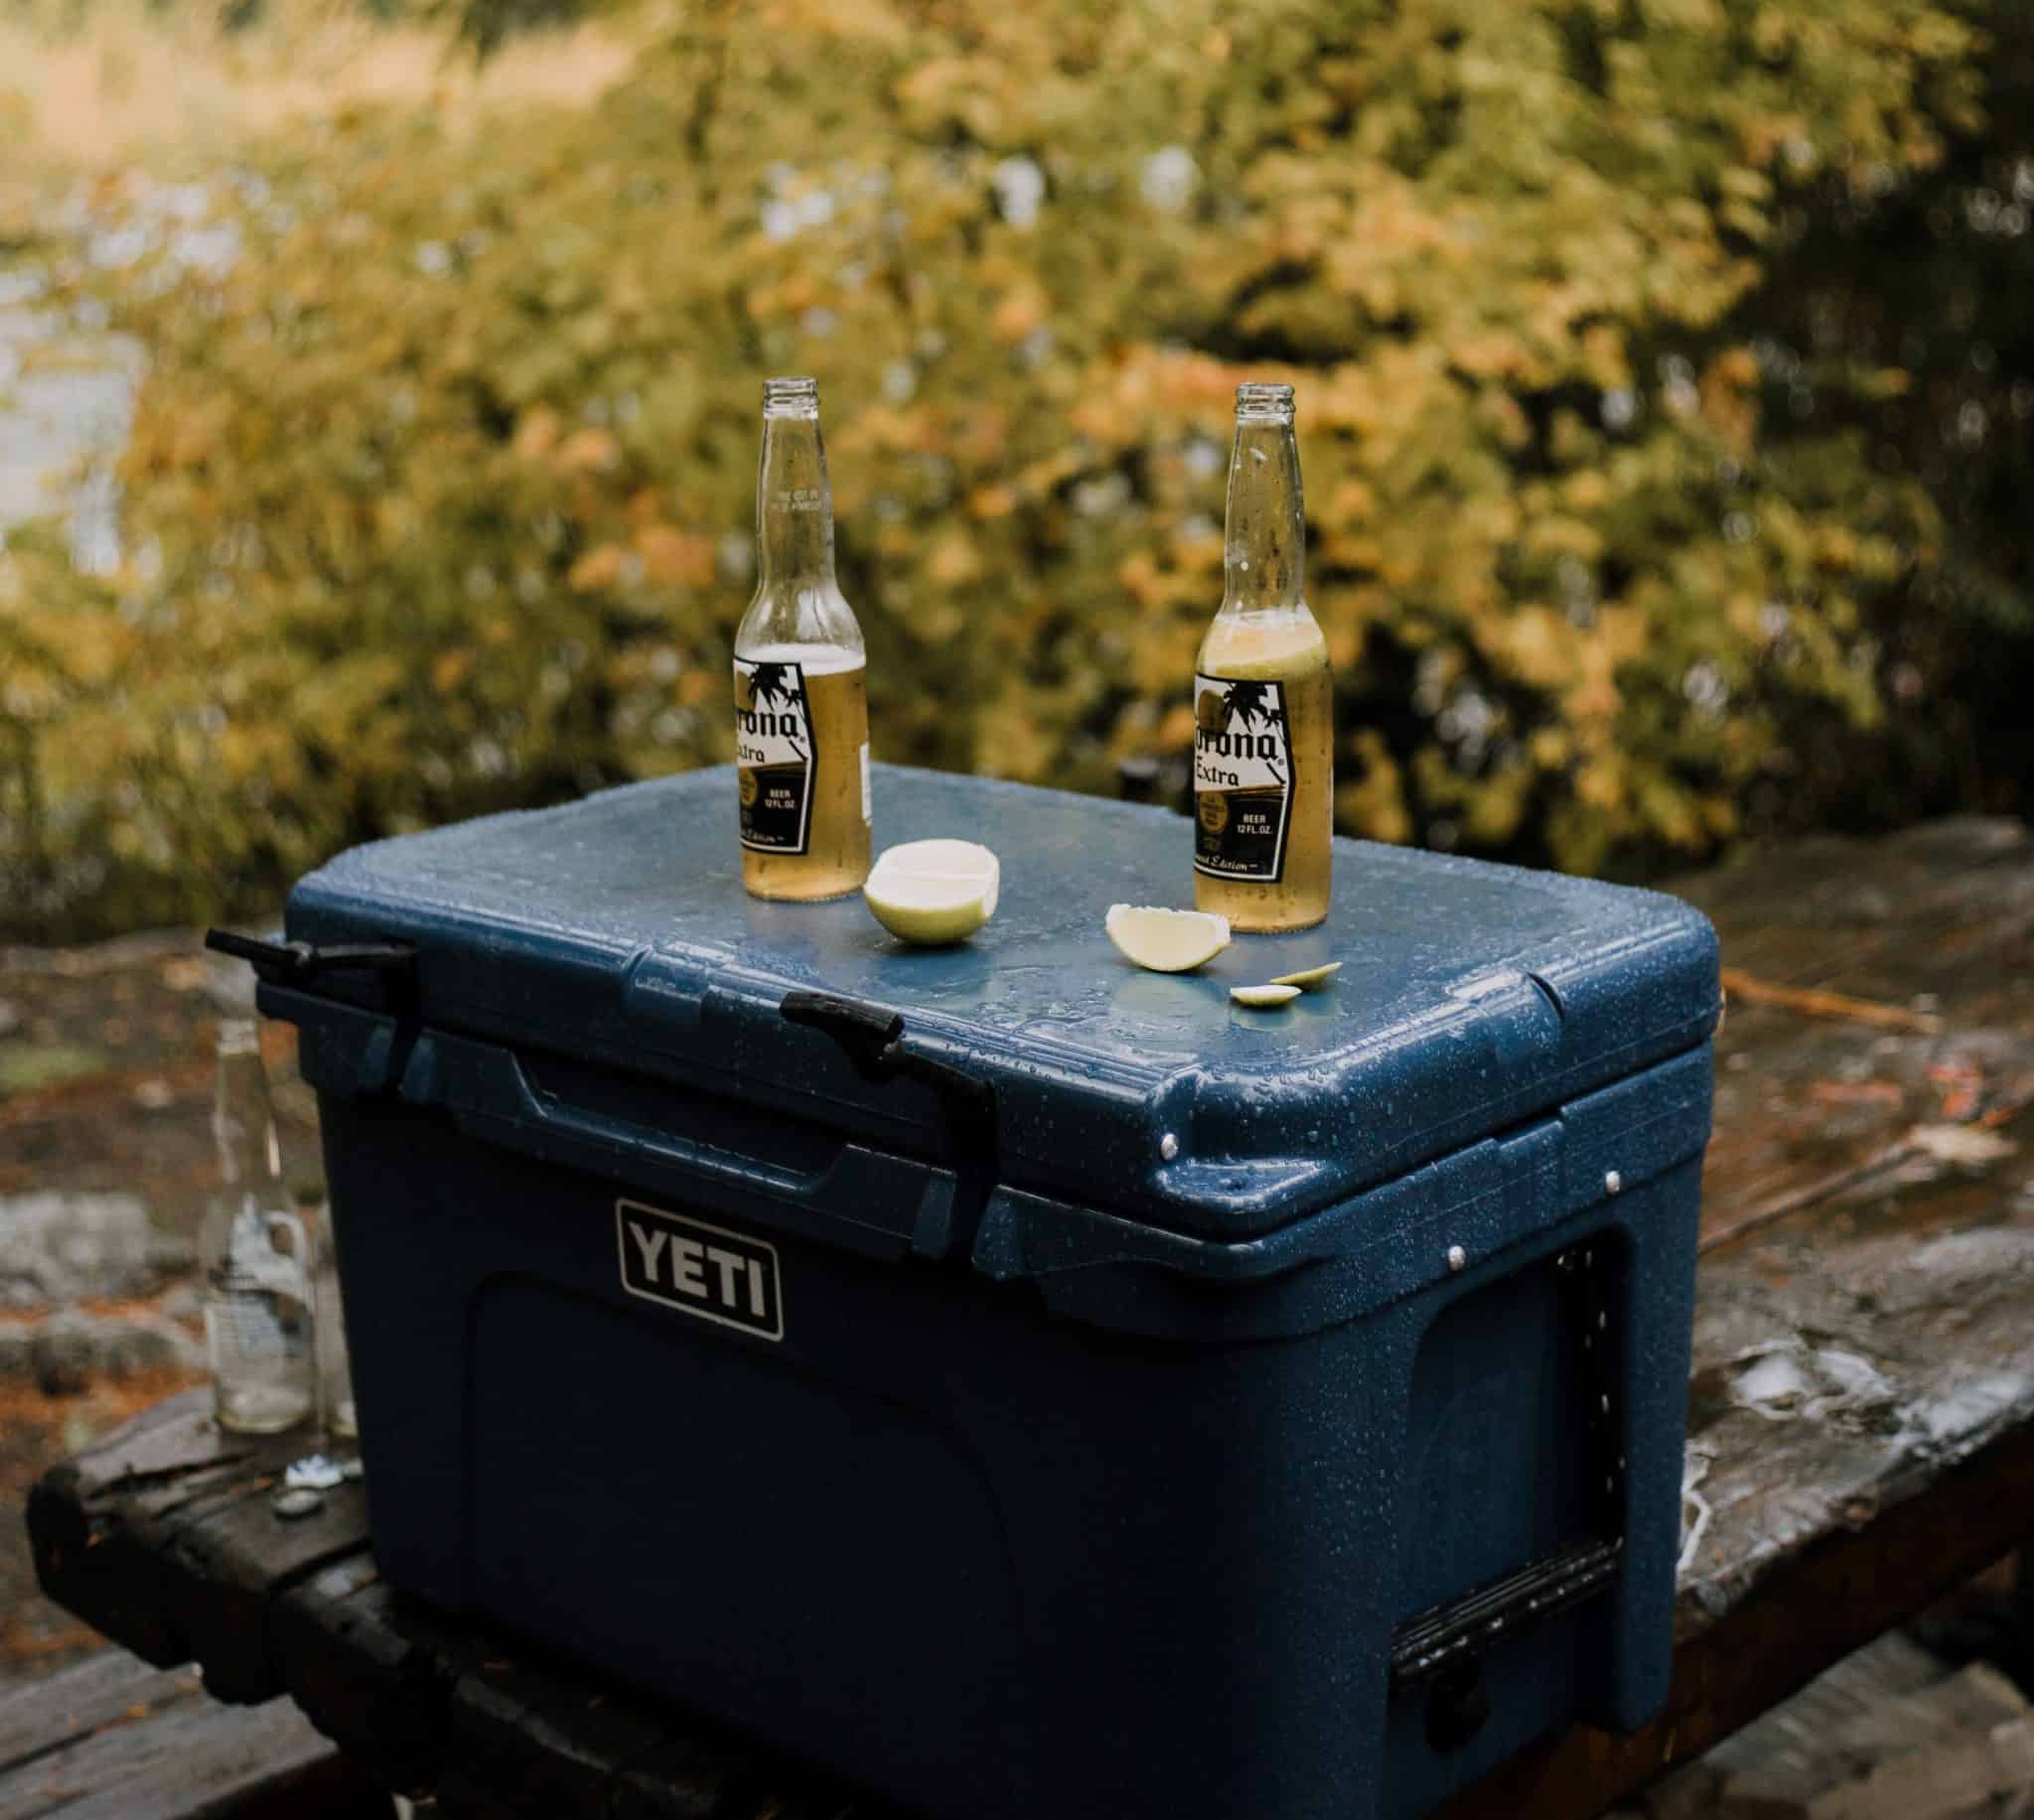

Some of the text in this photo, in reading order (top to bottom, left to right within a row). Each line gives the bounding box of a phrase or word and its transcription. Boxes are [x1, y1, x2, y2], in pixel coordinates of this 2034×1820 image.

[737, 709, 799, 738] rona
[1196, 727, 1278, 761] orona
[1196, 755, 1238, 785] Extra
[770, 789, 791, 798] BEER
[1242, 813, 1266, 824] BEER
[1211, 855, 1247, 872] Edition
[628, 1220, 766, 1319] YETI
